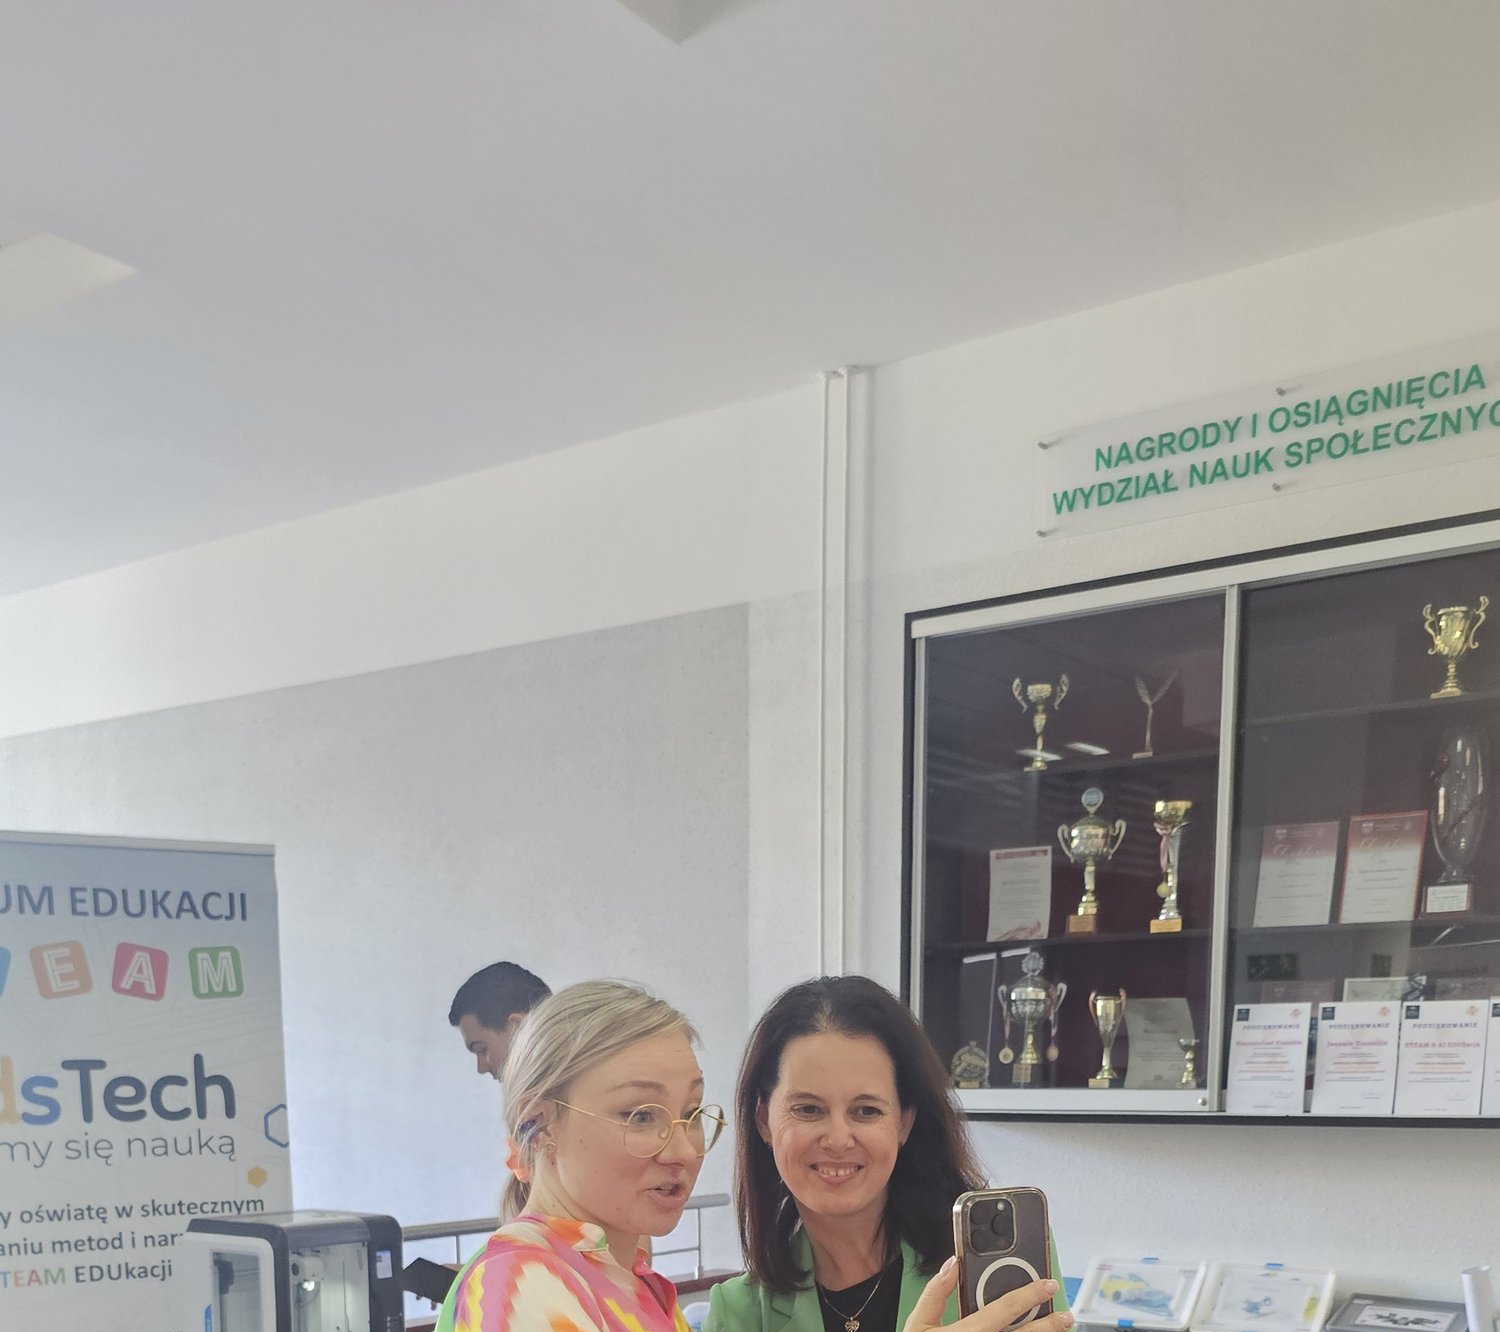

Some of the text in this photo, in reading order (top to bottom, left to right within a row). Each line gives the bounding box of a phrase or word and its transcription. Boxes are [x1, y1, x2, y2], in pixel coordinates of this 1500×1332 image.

[1094, 364, 1487, 472] NAGRODY I OSIĄGNIĘCIA
[1052, 469, 1179, 515] WYDZIAŁ
[1189, 447, 1275, 489] NAUK
[70, 887, 248, 921] EDUKACJI
[0, 1129, 237, 1169] my się nauką
[20, 1204, 108, 1224] oświatę
[115, 1205, 133, 1218] w
[140, 1197, 265, 1218] skutecznym
[51, 1232, 123, 1255] metod
[131, 1232, 136, 1249] i
[143, 1231, 184, 1248] nar
[0, 1259, 173, 1289] TEAM EDUkacji
